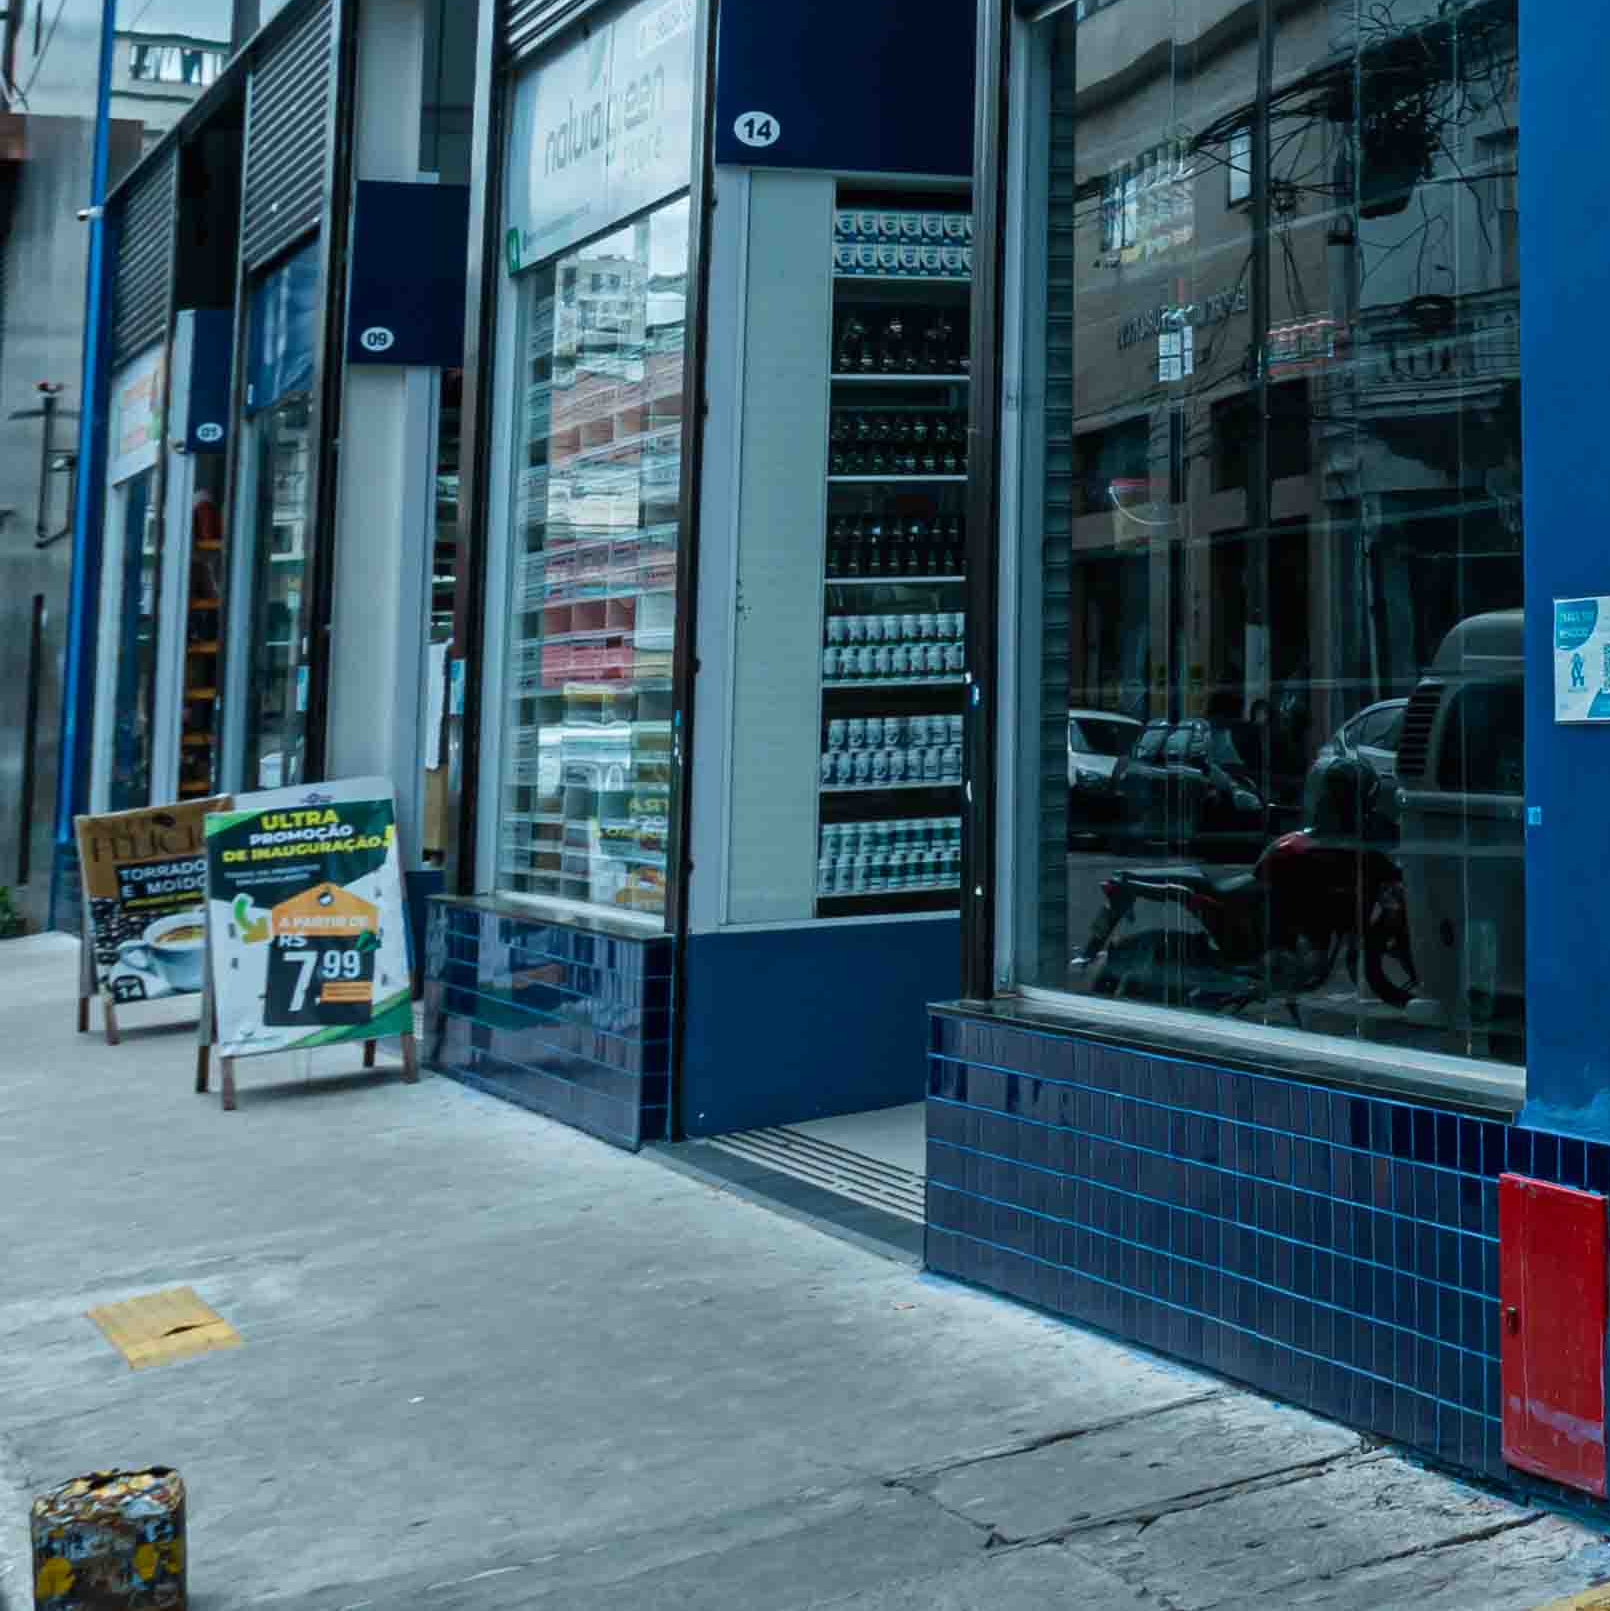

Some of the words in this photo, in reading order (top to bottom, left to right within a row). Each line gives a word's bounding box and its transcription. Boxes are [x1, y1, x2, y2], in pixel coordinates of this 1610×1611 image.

[744, 118, 772, 140] 14
[366, 332, 387, 346] 09
[261, 809, 340, 831] ULTRA
[249, 823, 354, 846] PROMOÇÃO
[222, 849, 248, 863] DE
[119, 860, 208, 881] TORRADO
[121, 884, 136, 898] E
